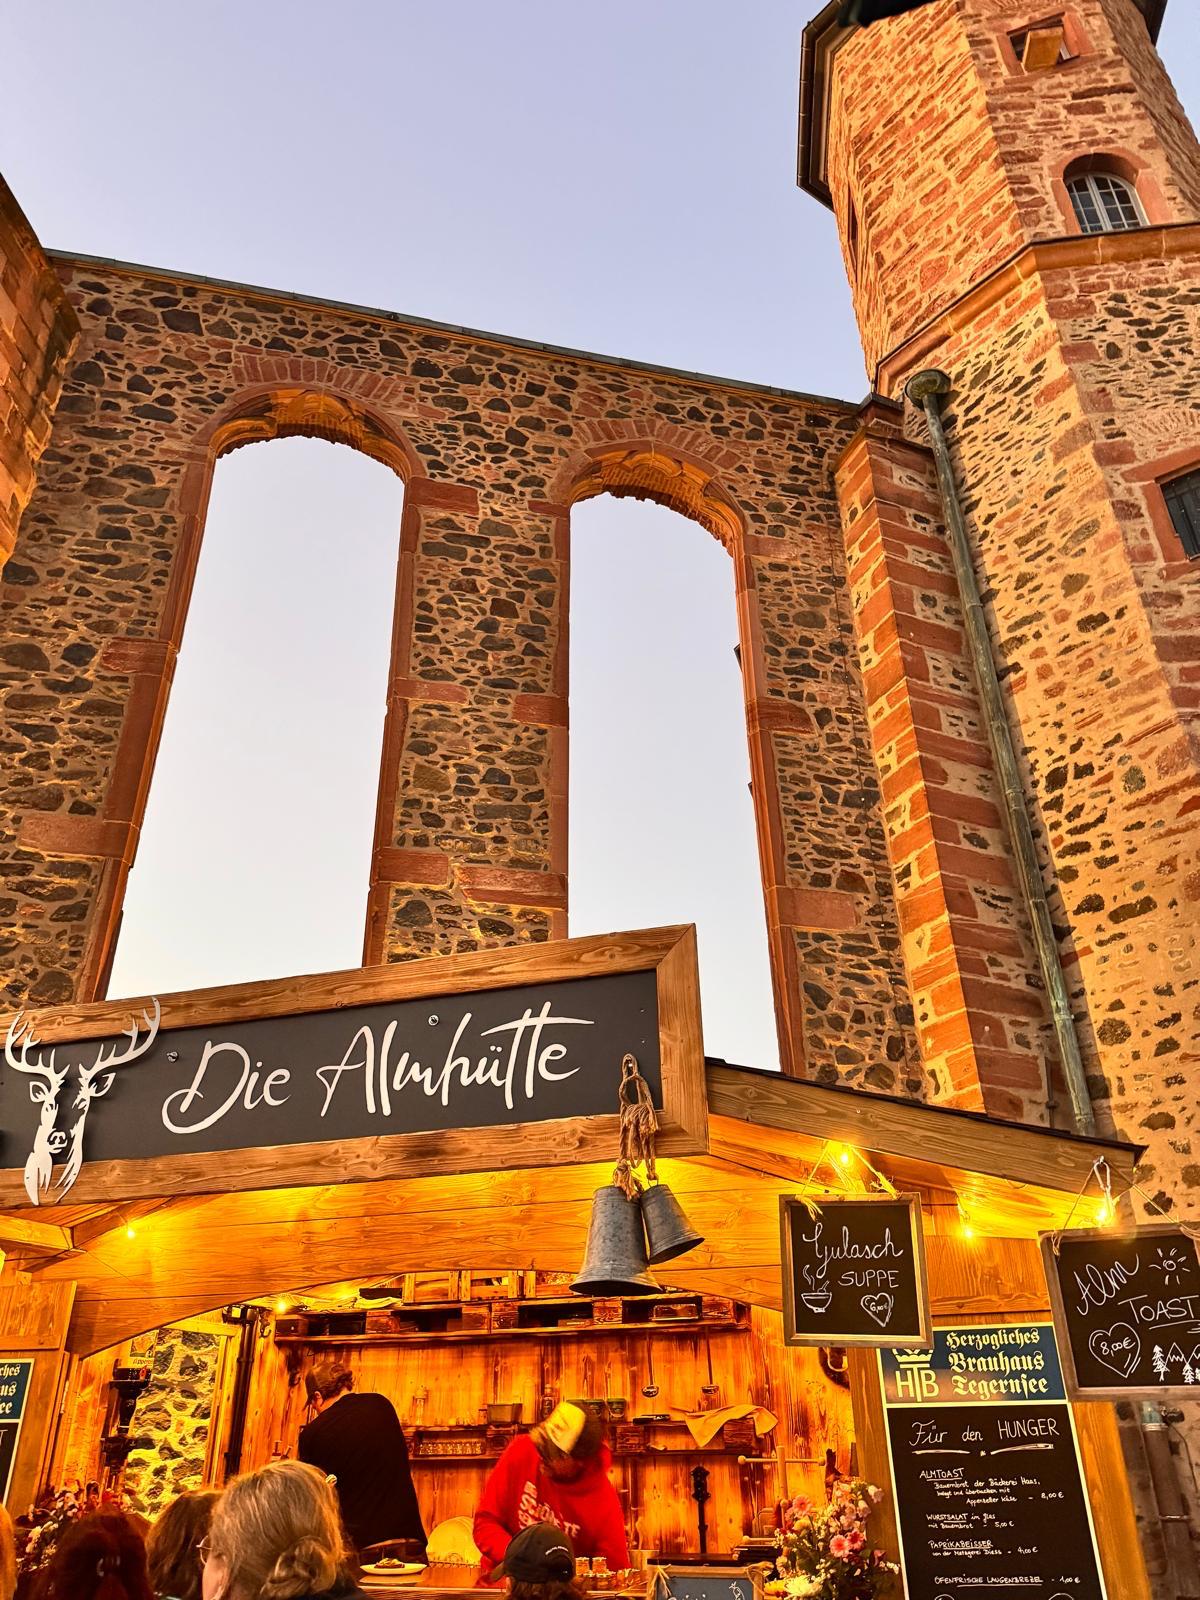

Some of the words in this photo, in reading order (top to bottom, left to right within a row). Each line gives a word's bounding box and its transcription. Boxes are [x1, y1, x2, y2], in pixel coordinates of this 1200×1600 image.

[161, 1040, 292, 1135] Die
[317, 1001, 595, 1118] Almhütte
[802, 1222, 904, 1279] Gulasch
[838, 1269, 899, 1289] SUPPE
[1073, 1253, 1139, 1316] Alm
[1117, 1293, 1200, 1324] TOAST
[946, 1328, 1041, 1350] Herzogliches
[948, 1350, 1045, 1375] Brauhaus
[909, 1420, 948, 1446] Für
[962, 1426, 983, 1442] den
[998, 1418, 1059, 1440] HUNGER
[919, 1467, 964, 1478] ALMTOAST
[974, 1479, 985, 1487] der
